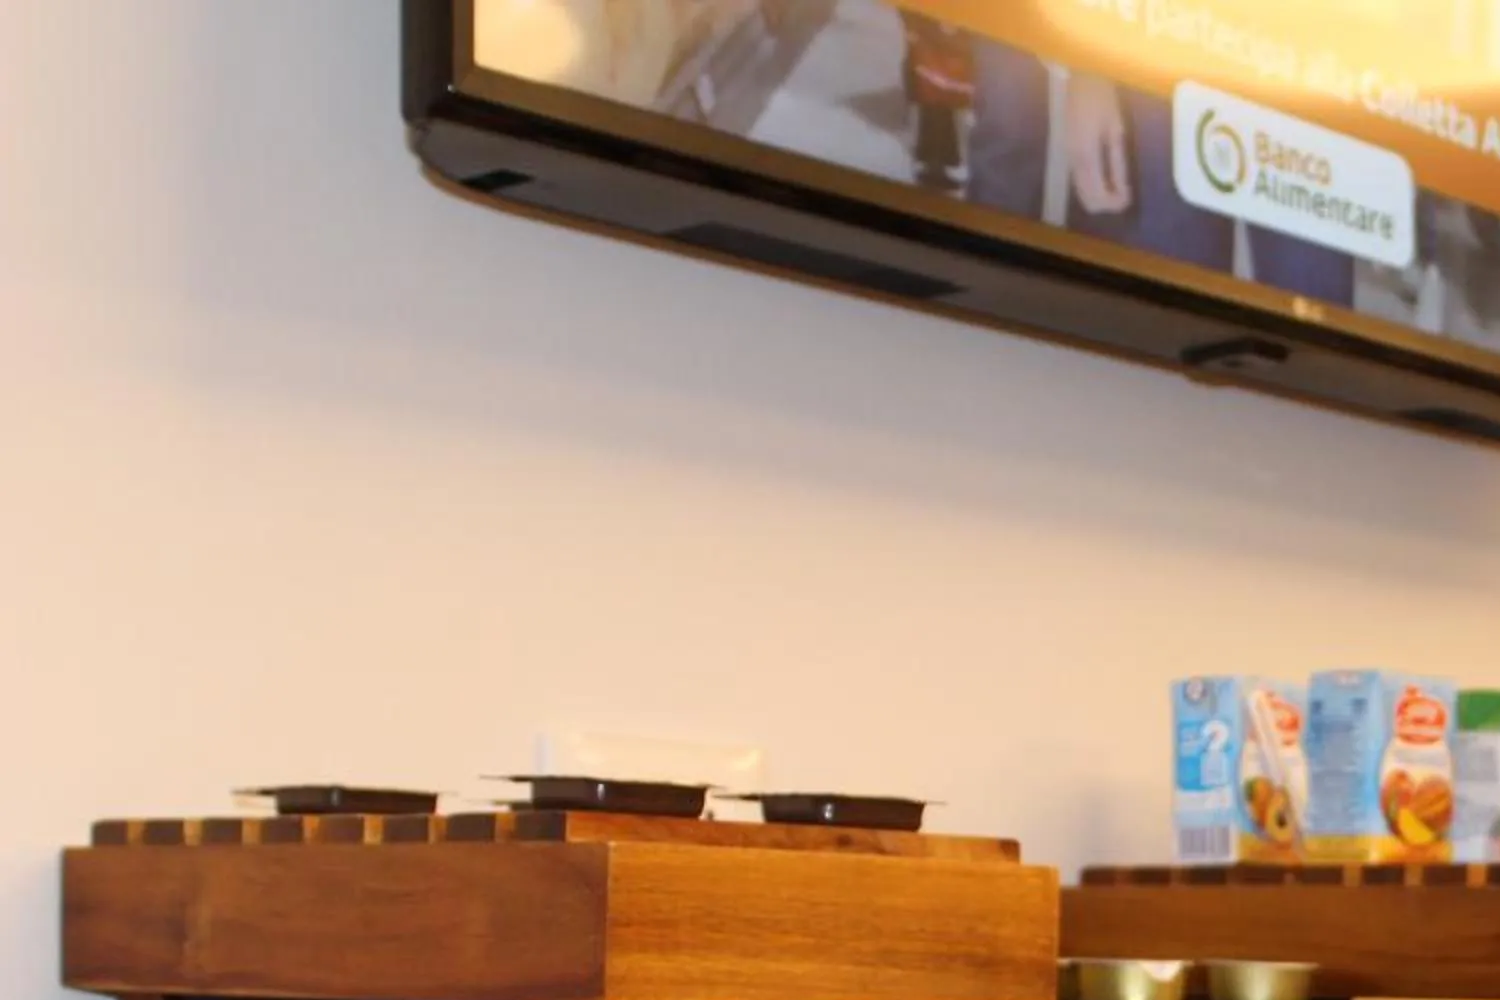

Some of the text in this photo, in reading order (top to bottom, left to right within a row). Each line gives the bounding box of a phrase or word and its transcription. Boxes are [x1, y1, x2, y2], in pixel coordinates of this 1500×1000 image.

[1360, 70, 1478, 149] Colletta
[1254, 131, 1332, 187] Banco
[1253, 167, 1395, 240] Alimentare
